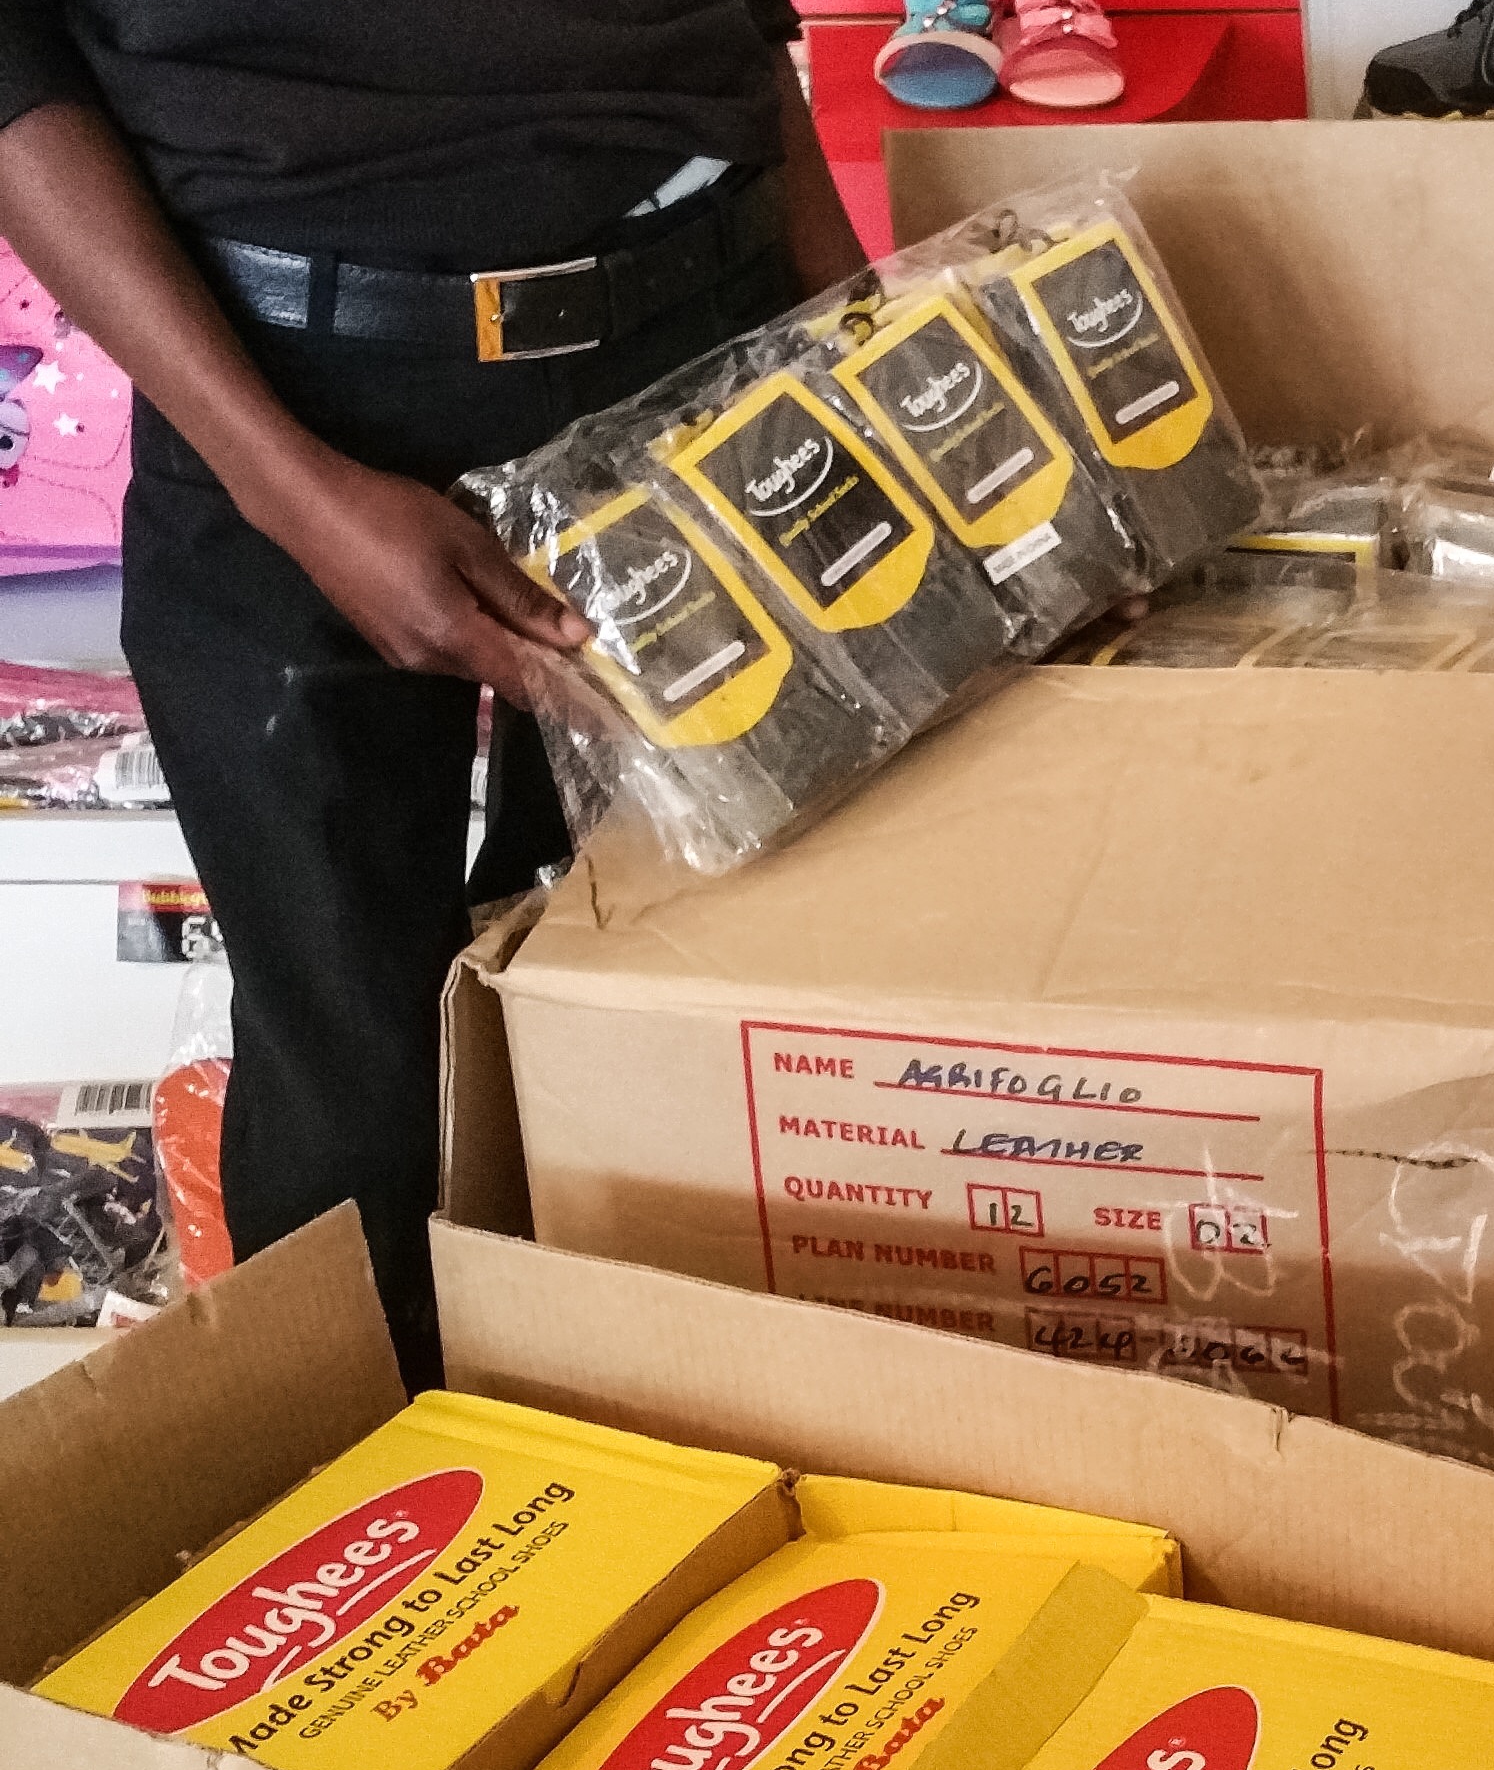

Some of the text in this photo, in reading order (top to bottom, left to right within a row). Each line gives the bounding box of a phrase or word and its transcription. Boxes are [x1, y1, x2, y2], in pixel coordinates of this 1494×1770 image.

[773, 1052, 1143, 1105] NAME AGRIFOGLIO
[779, 1115, 926, 1149] MATERIAL
[783, 1176, 933, 1210] QUANTITY
[987, 1202, 1034, 1227] 12
[1094, 1207, 1162, 1230] SIZE
[792, 1234, 864, 1262] PLAN
[874, 1242, 997, 1274] NUMBER
[148, 1515, 421, 1691] Toughees
[299, 1520, 569, 1740] GENUINE LEATHER SCHOOL SHOES
[305, 1613, 415, 1693] Strong
[403, 1587, 443, 1616] to
[434, 1536, 506, 1587] Last
[493, 1481, 576, 1536] Long
[371, 1605, 520, 1722] By Bata
[818, 1694, 859, 1727] to
[843, 1646, 916, 1695] Last
[904, 1591, 981, 1645] Long
[866, 1672, 935, 1730] SCHOOL
[925, 1626, 978, 1672] SHOES
